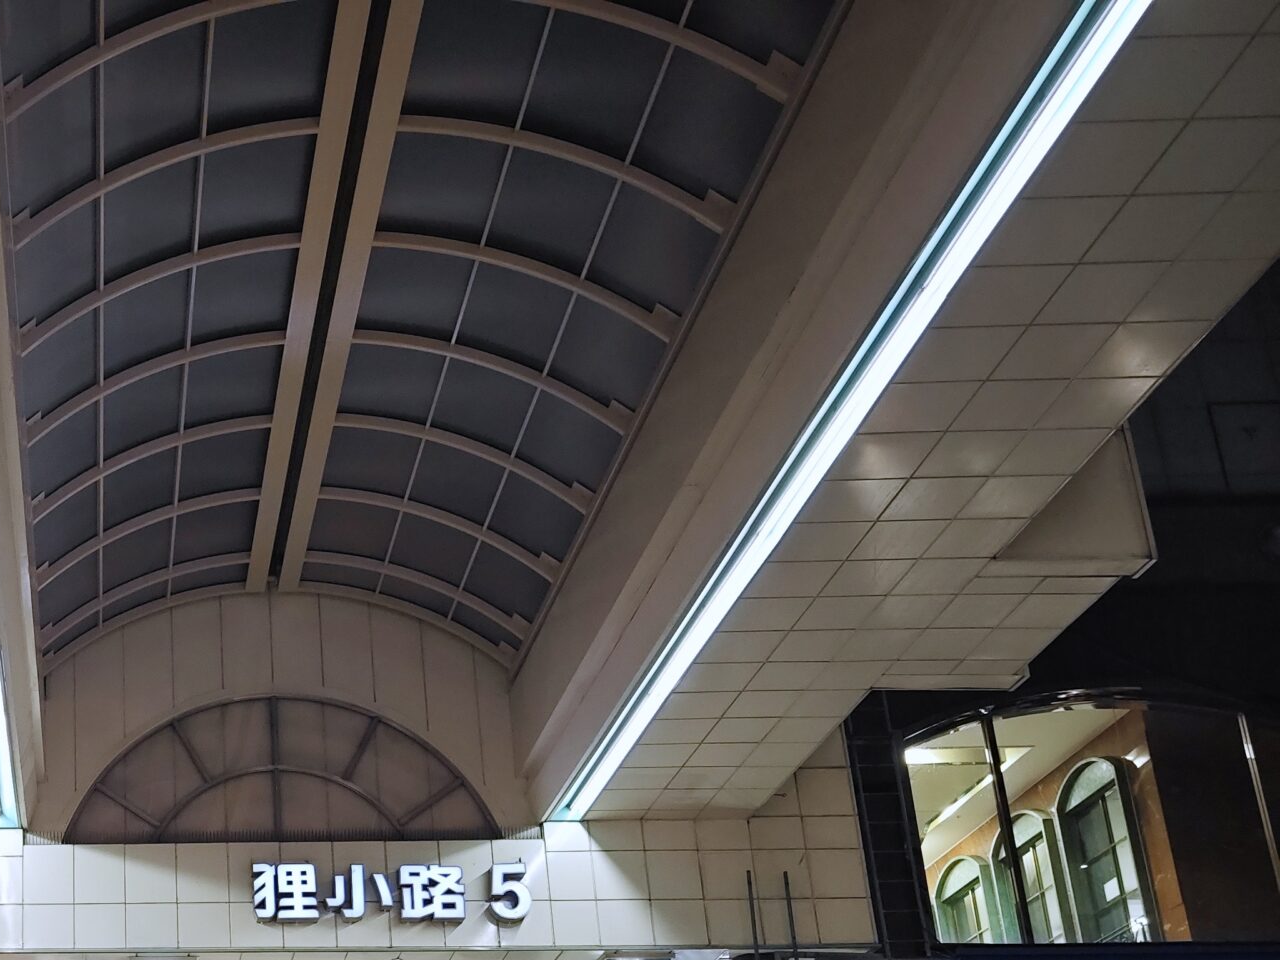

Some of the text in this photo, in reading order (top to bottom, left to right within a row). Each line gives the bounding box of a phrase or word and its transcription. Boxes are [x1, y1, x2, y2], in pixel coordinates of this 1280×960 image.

[252, 862, 533, 921] 狸小路 5
